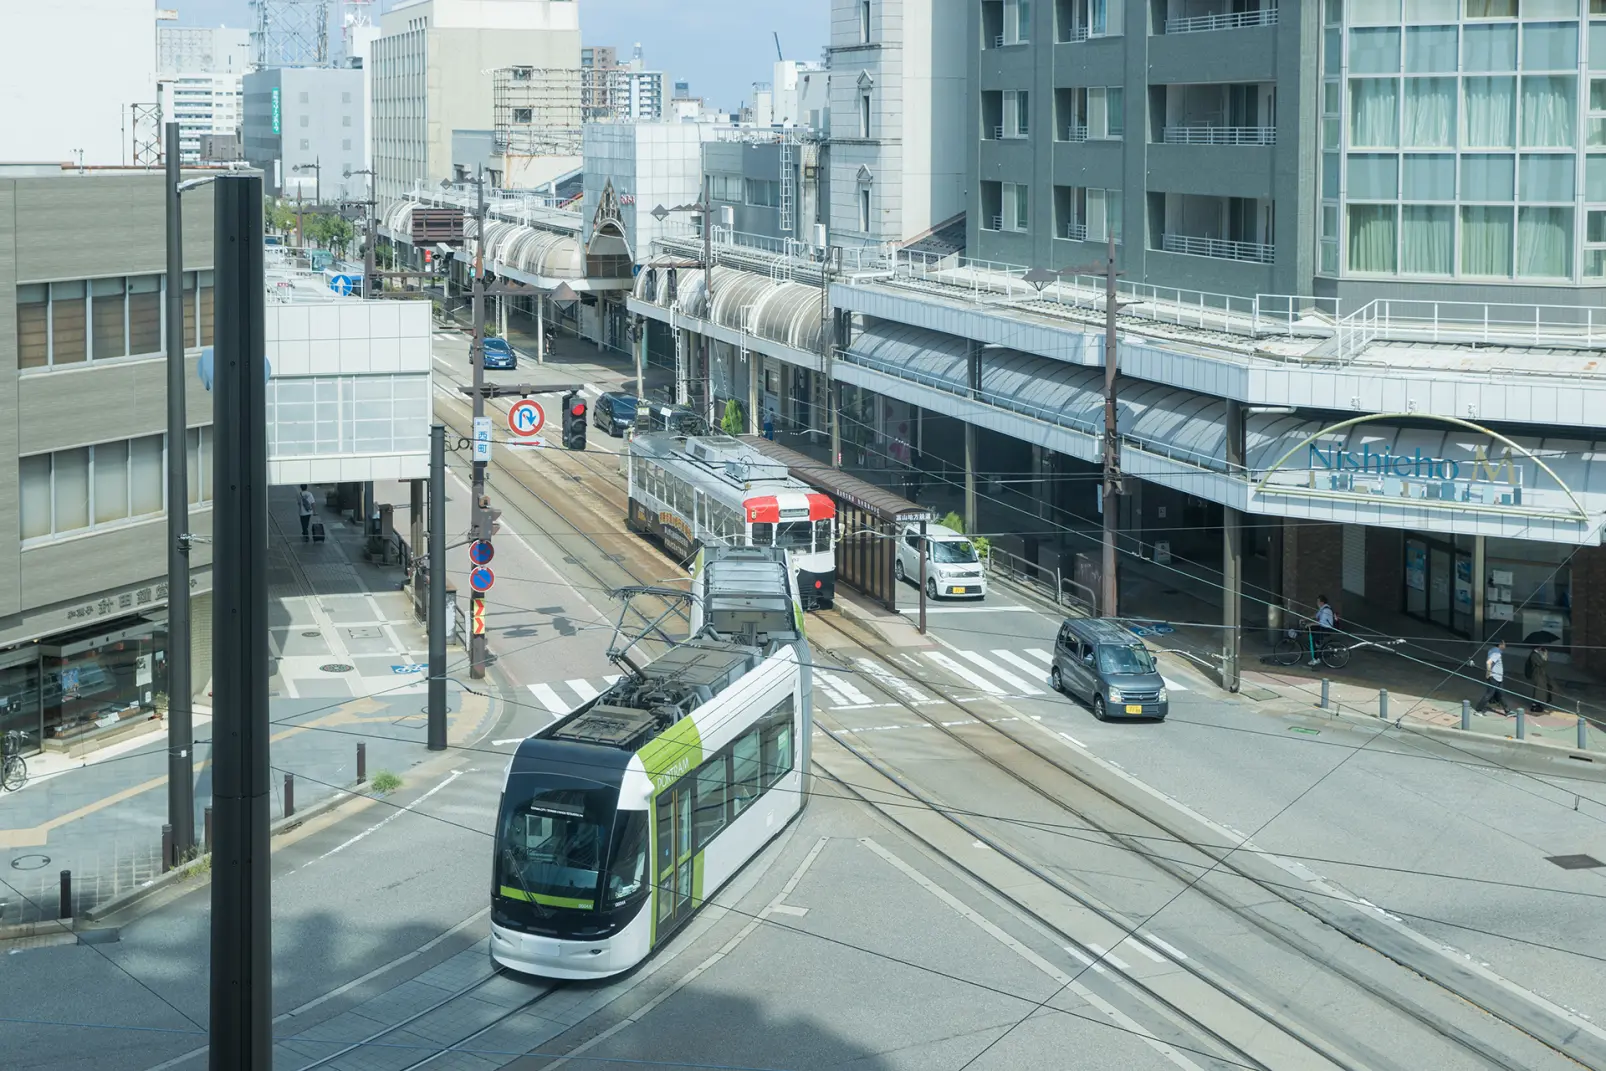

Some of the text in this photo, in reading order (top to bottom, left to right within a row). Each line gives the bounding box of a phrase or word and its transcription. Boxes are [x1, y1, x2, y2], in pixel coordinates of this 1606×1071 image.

[478, 431, 488, 454] 西町
[1309, 441, 1460, 481] Nishicho
[657, 757, 689, 790] PORTRAM
